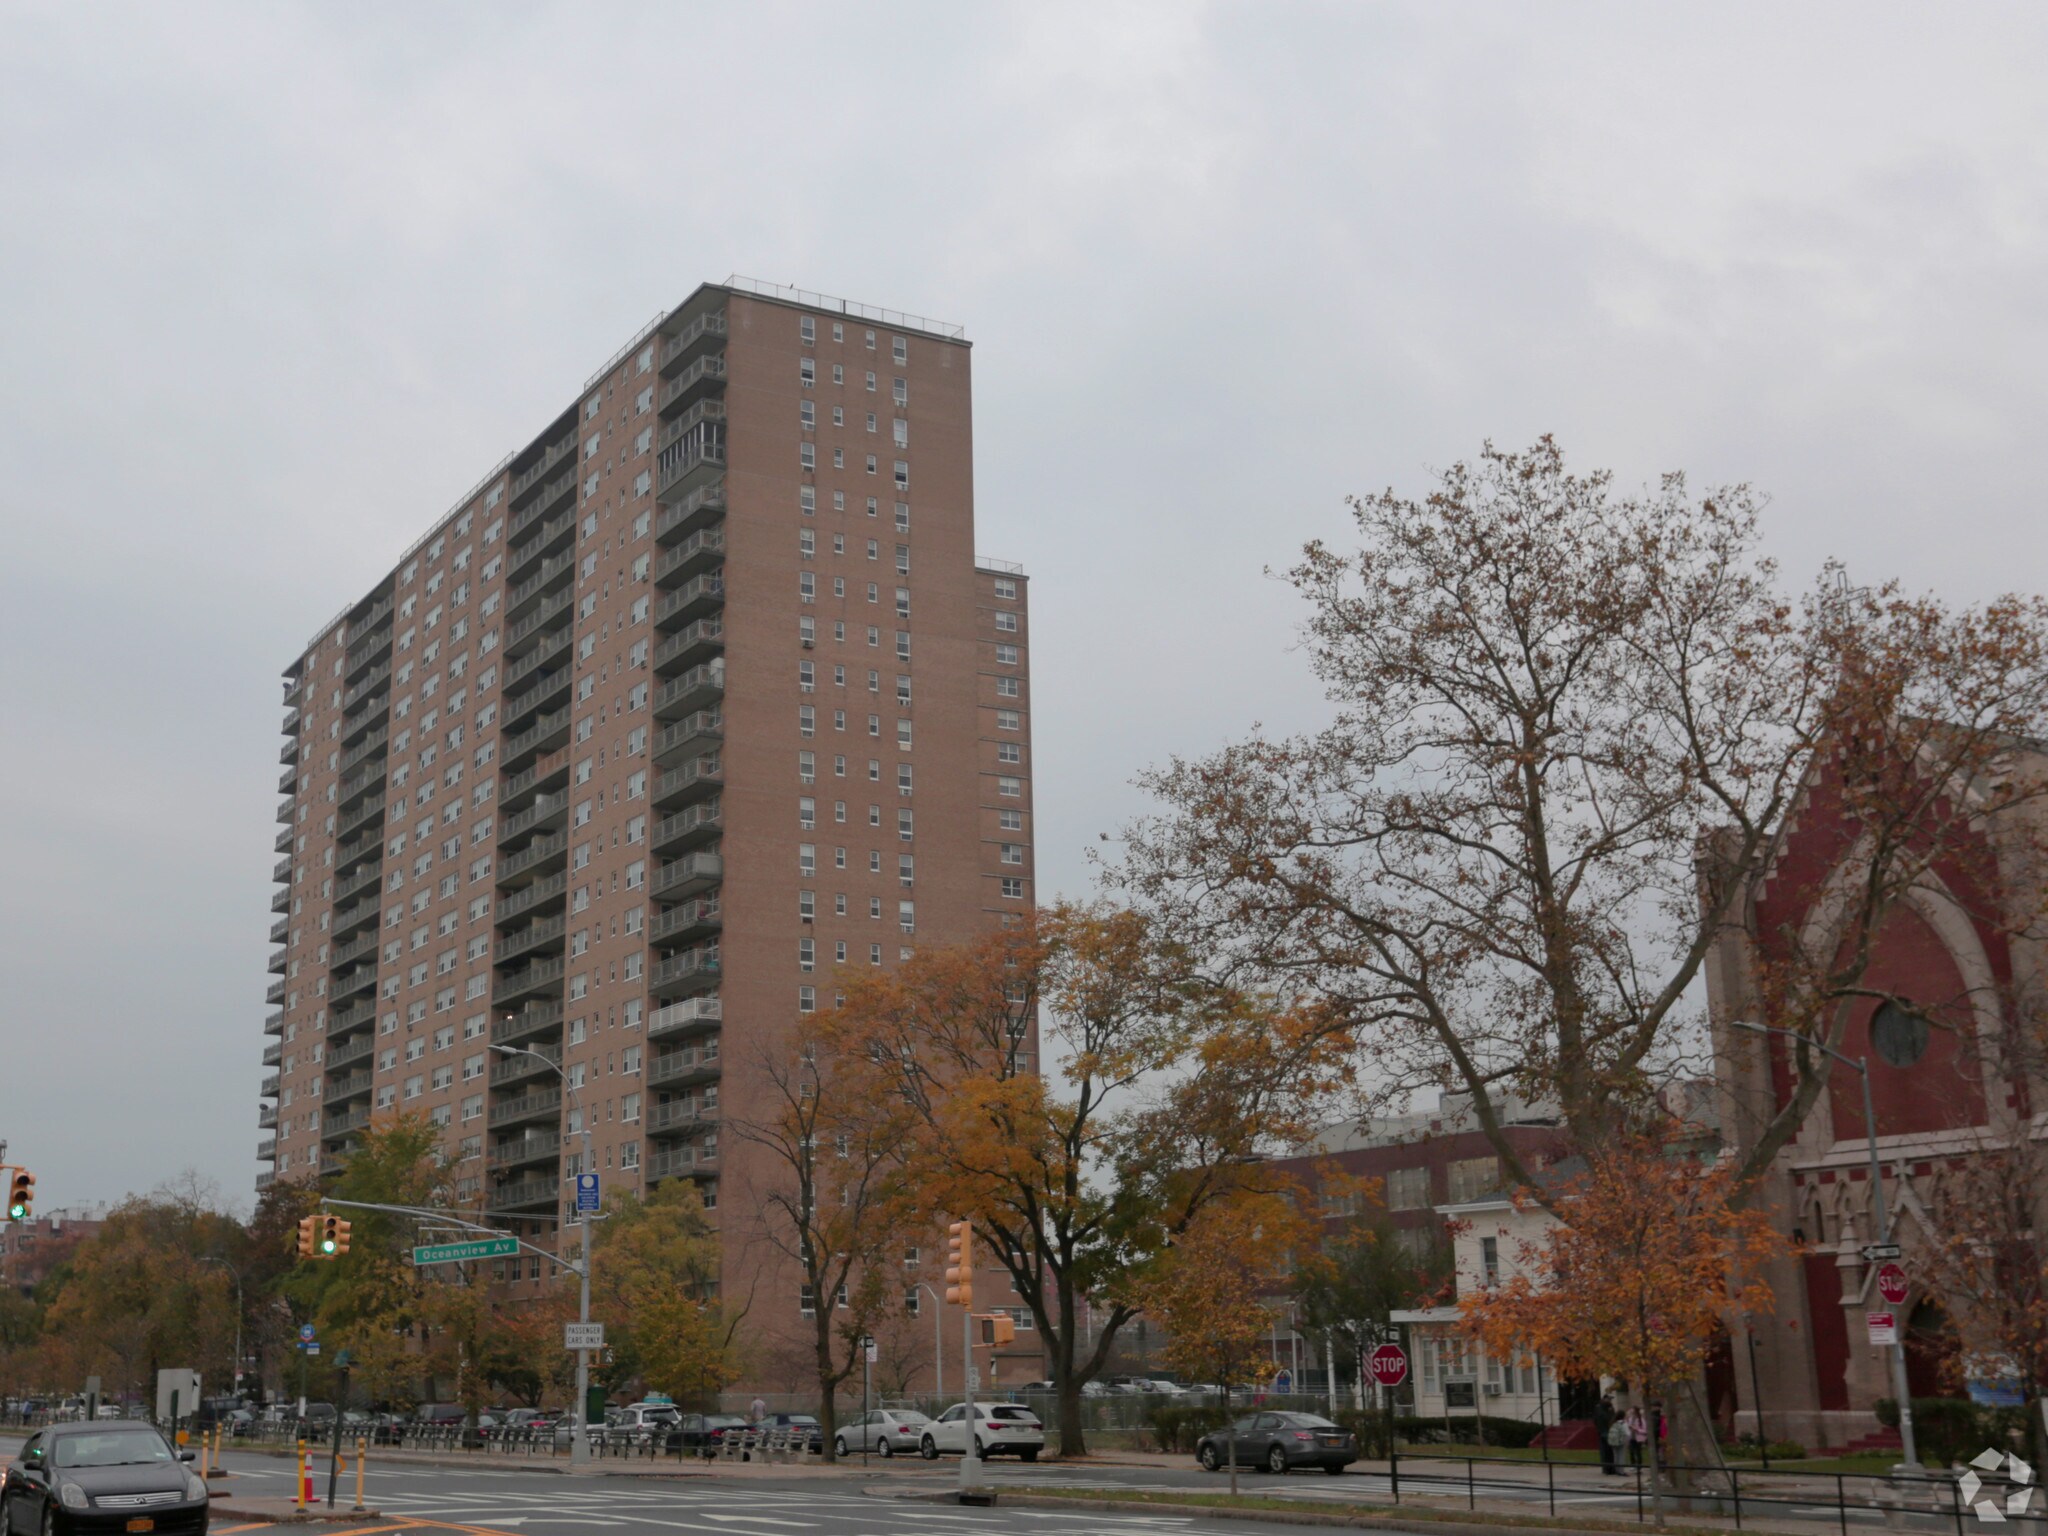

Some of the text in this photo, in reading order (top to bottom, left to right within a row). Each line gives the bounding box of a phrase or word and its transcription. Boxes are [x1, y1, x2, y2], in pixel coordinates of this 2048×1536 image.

[423, 1242, 510, 1260] Oceanview Av
[1880, 1275, 1906, 1291] STO
[568, 1326, 601, 1335] PASSENGER
[568, 1336, 600, 1345] CARS ONLY
[1373, 1357, 1404, 1373] STOP
